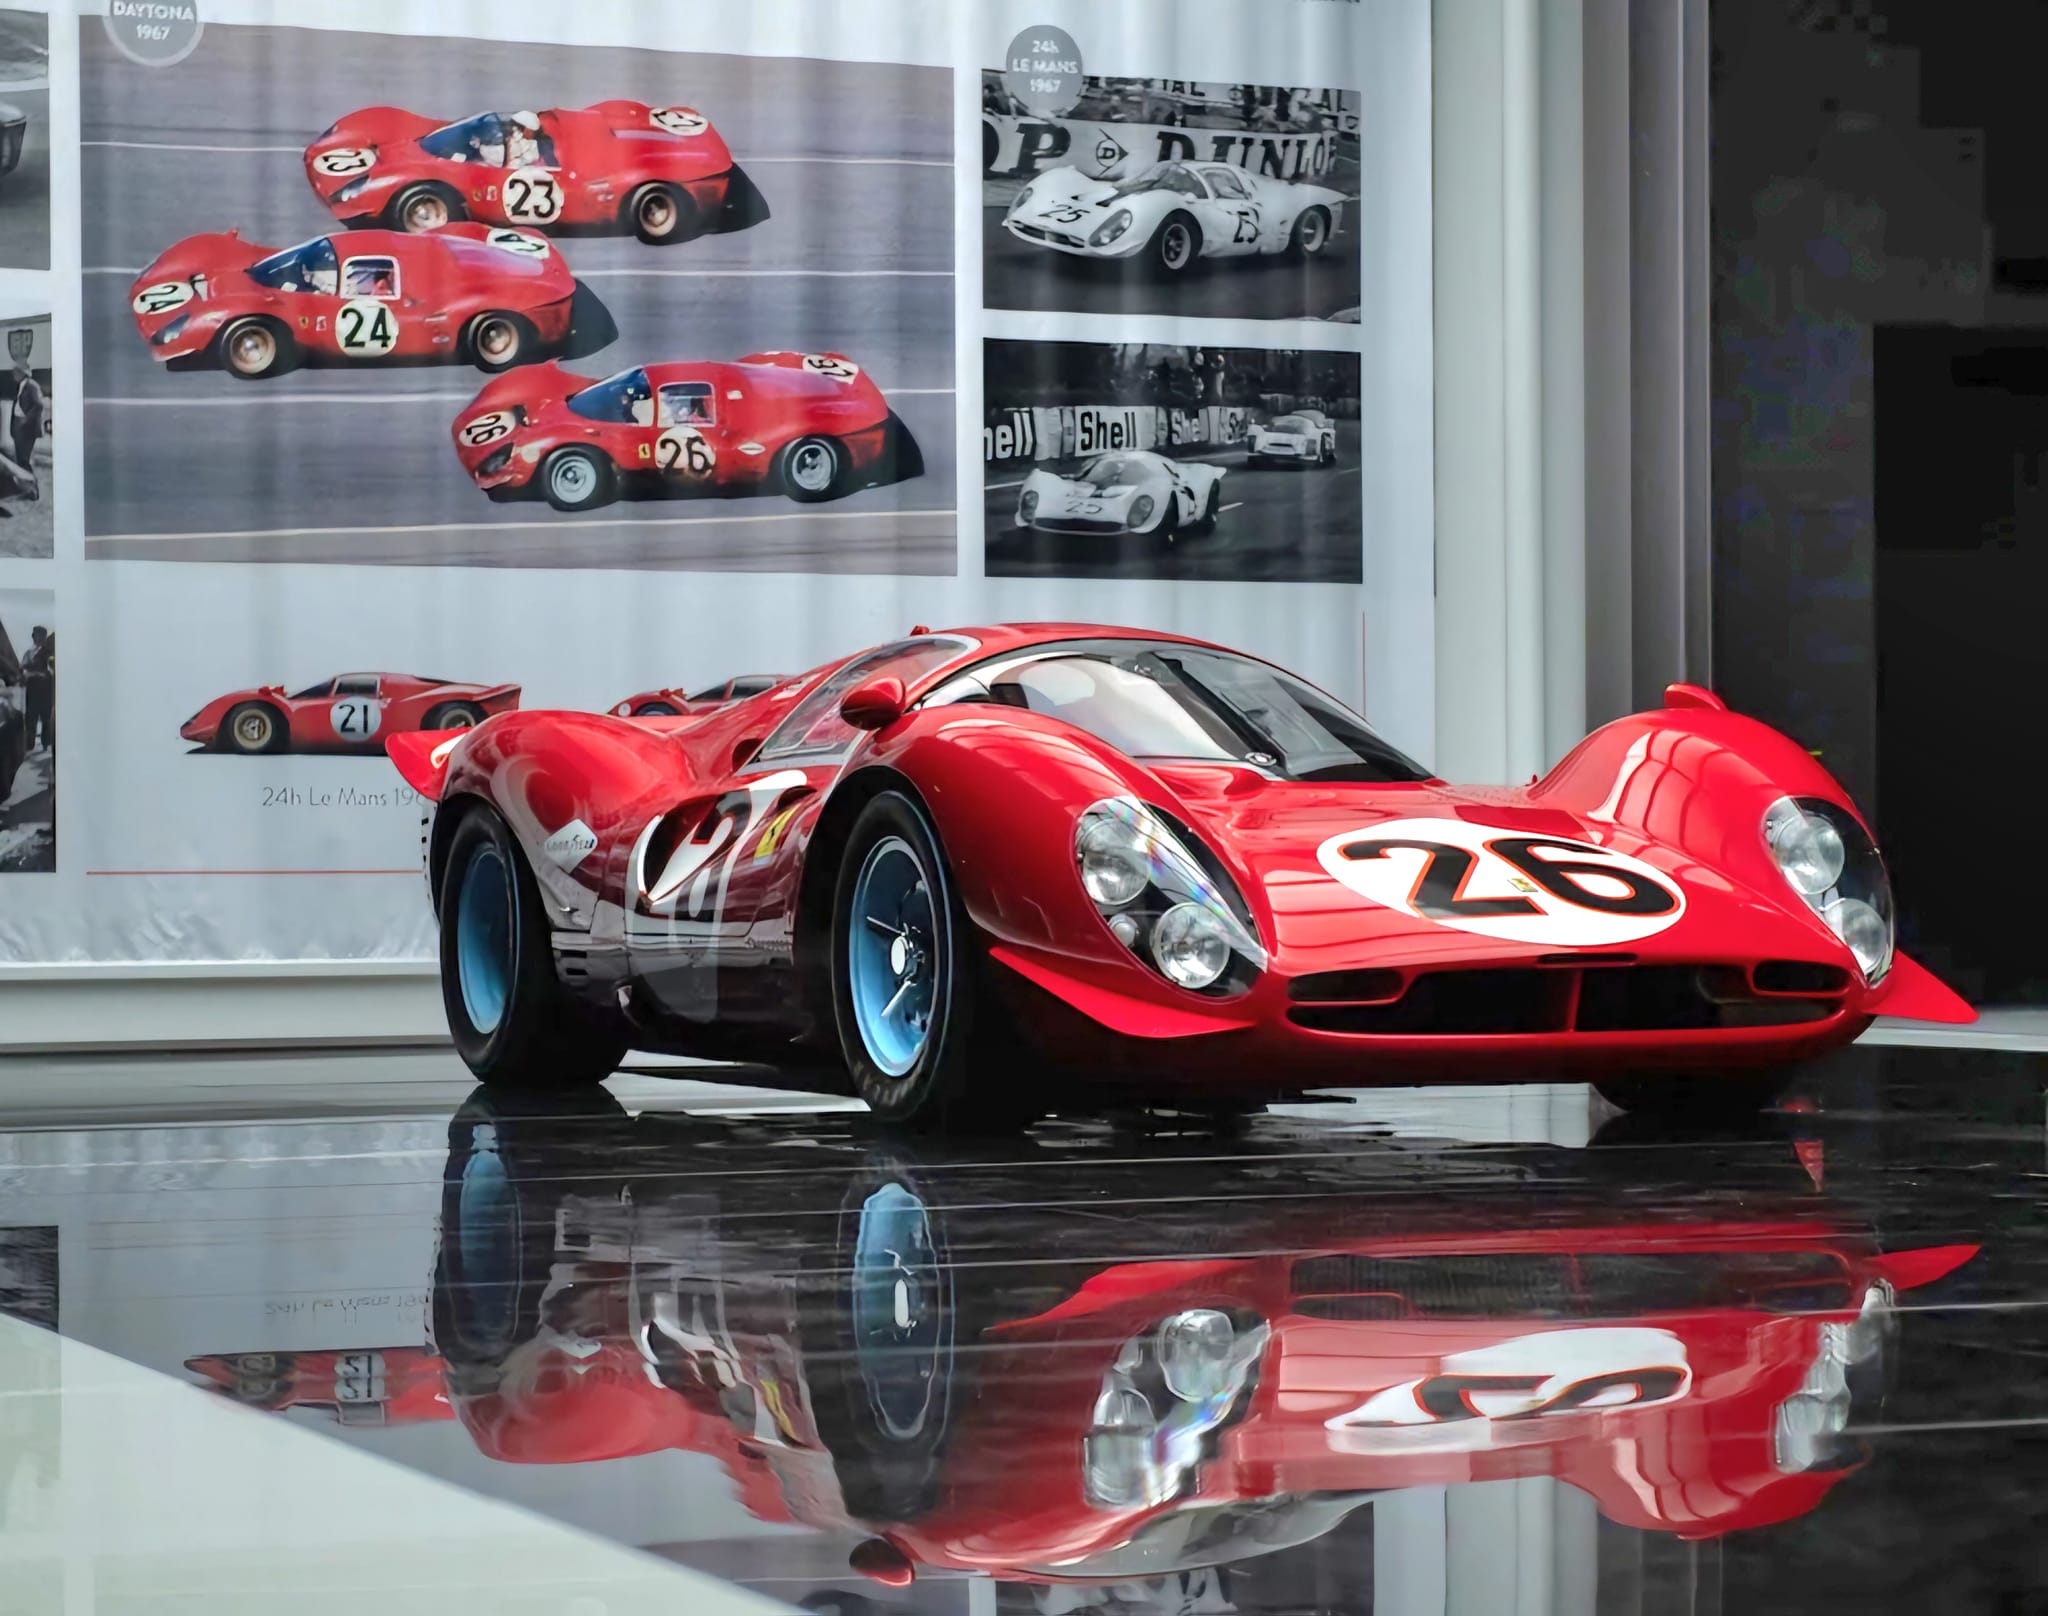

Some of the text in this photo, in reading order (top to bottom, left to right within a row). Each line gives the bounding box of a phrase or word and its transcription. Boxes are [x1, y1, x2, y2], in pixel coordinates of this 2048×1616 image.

[112, 0, 196, 20] DAYTONA
[136, 23, 171, 40] 1967
[1012, 58, 1079, 75] LE MANS
[508, 178, 556, 218] 23
[1038, 204, 1092, 223] 25
[341, 307, 392, 348] 24
[465, 414, 508, 445] 26
[1080, 410, 1138, 451] Shell
[660, 436, 713, 475] 26
[338, 703, 369, 734] 21
[262, 786, 302, 807] 24h
[309, 786, 331, 807] Le
[338, 786, 387, 807] Mans
[1337, 837, 1682, 921] 26
